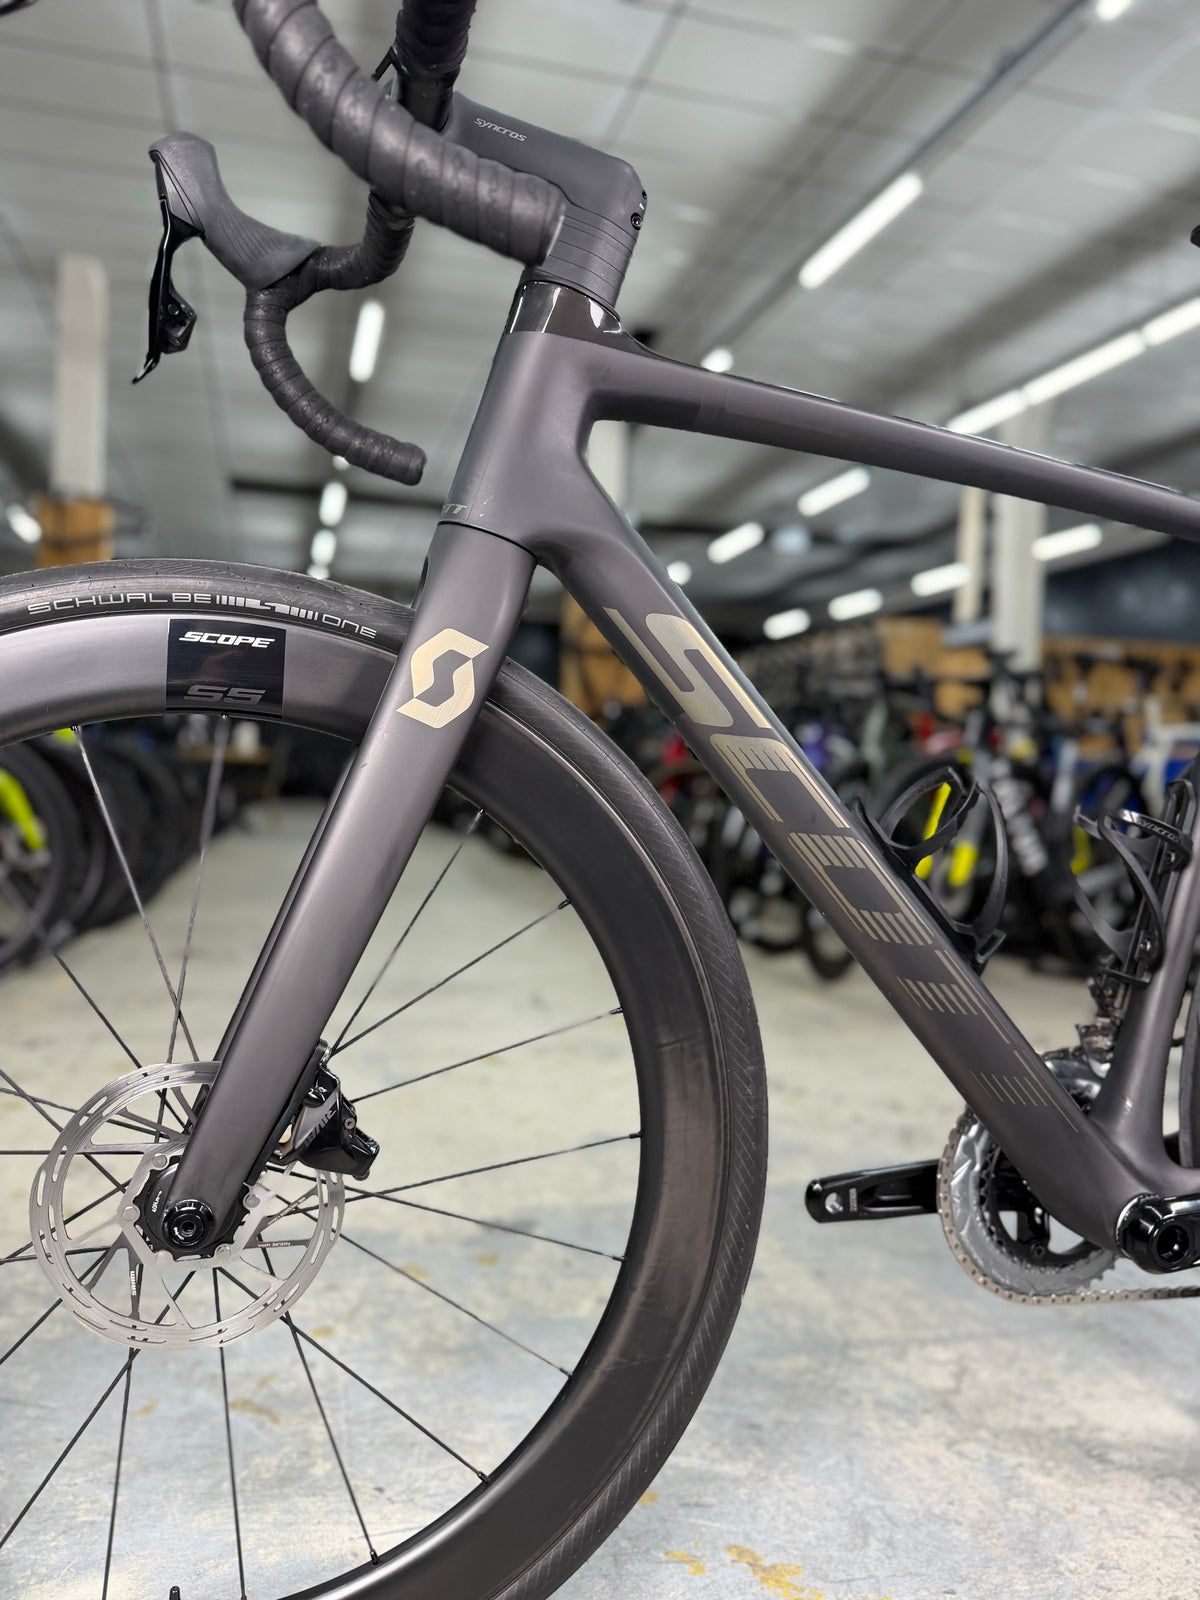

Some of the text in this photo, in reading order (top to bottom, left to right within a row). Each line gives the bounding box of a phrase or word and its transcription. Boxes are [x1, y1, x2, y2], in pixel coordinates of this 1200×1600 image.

[473, 117, 528, 142] syncros
[27, 592, 377, 640] SCHWALBE ONE
[178, 630, 276, 649] SCOPE
